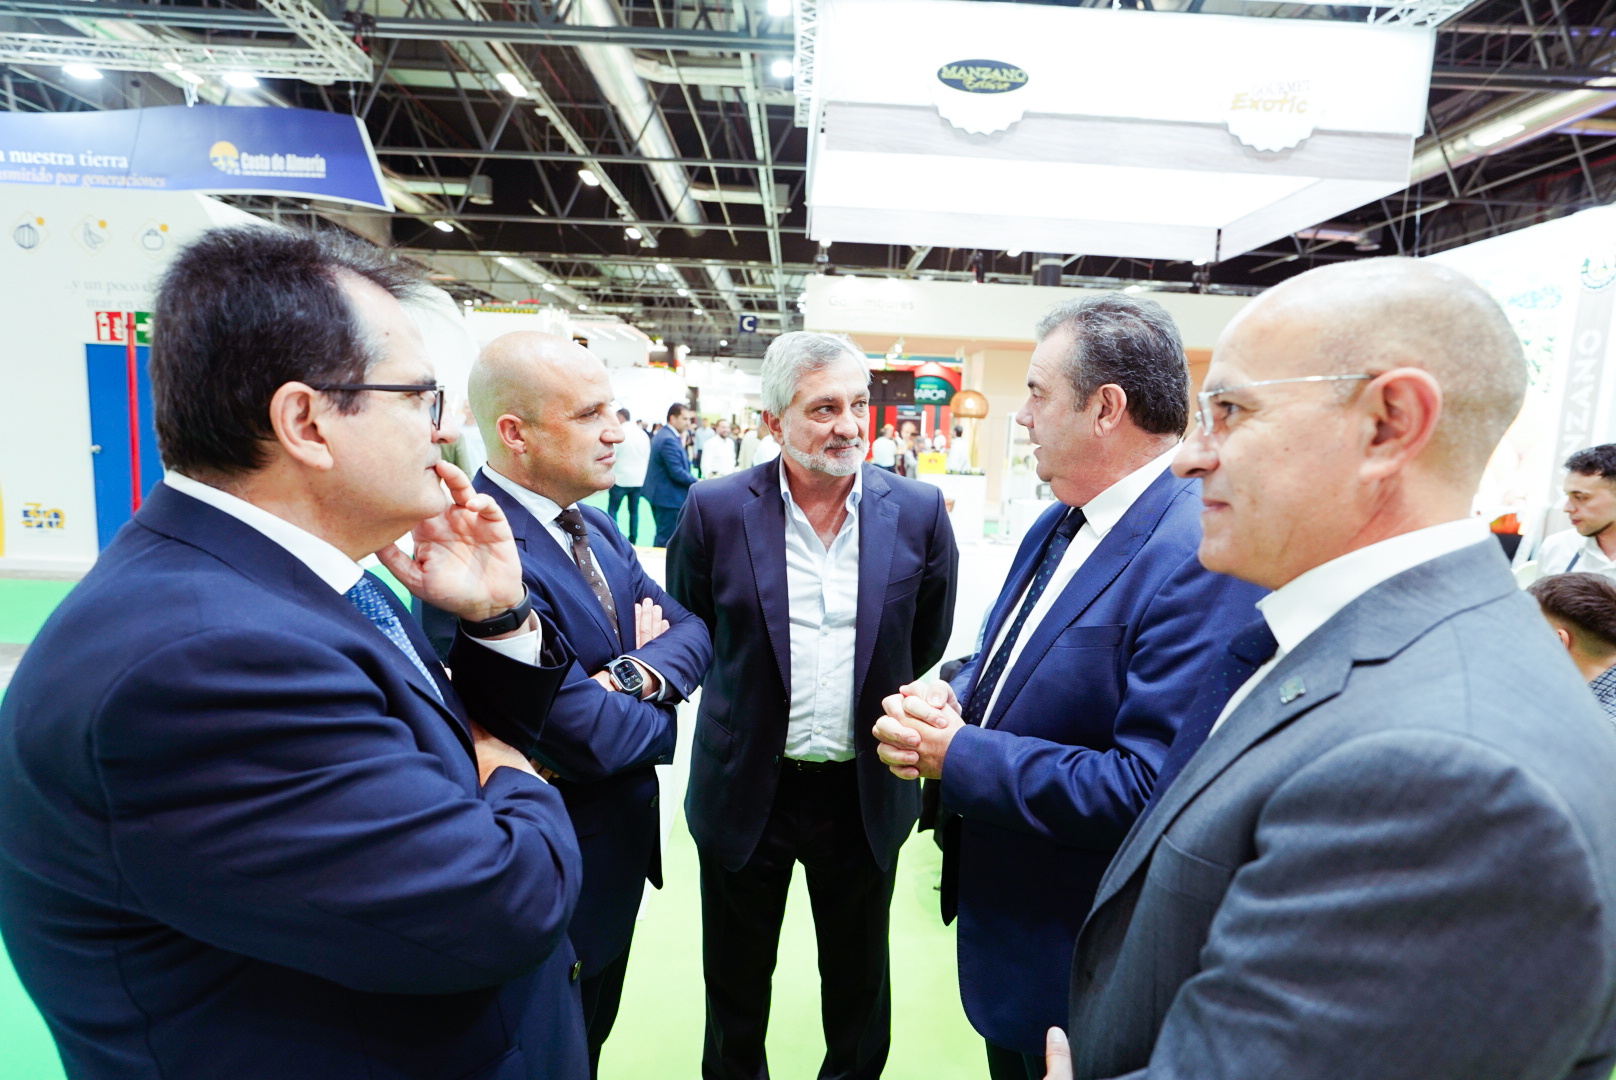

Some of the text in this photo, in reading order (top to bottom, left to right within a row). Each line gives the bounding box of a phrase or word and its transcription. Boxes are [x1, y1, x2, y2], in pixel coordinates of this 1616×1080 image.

[941, 65, 1026, 81] MANZANO
[1229, 90, 1308, 114] Exotic
[8, 149, 75, 165] nuestra
[79, 149, 128, 168] tierra
[241, 152, 270, 170] Costa
[272, 154, 284, 170] de
[55, 171, 80, 186] por
[82, 172, 167, 188] generaciones
[83, 280, 102, 290] un
[106, 281, 139, 295] poco
[86, 298, 113, 308] mar
[116, 299, 134, 309] en
[742, 316, 755, 331] C
[1552, 328, 1602, 509] NZANO
